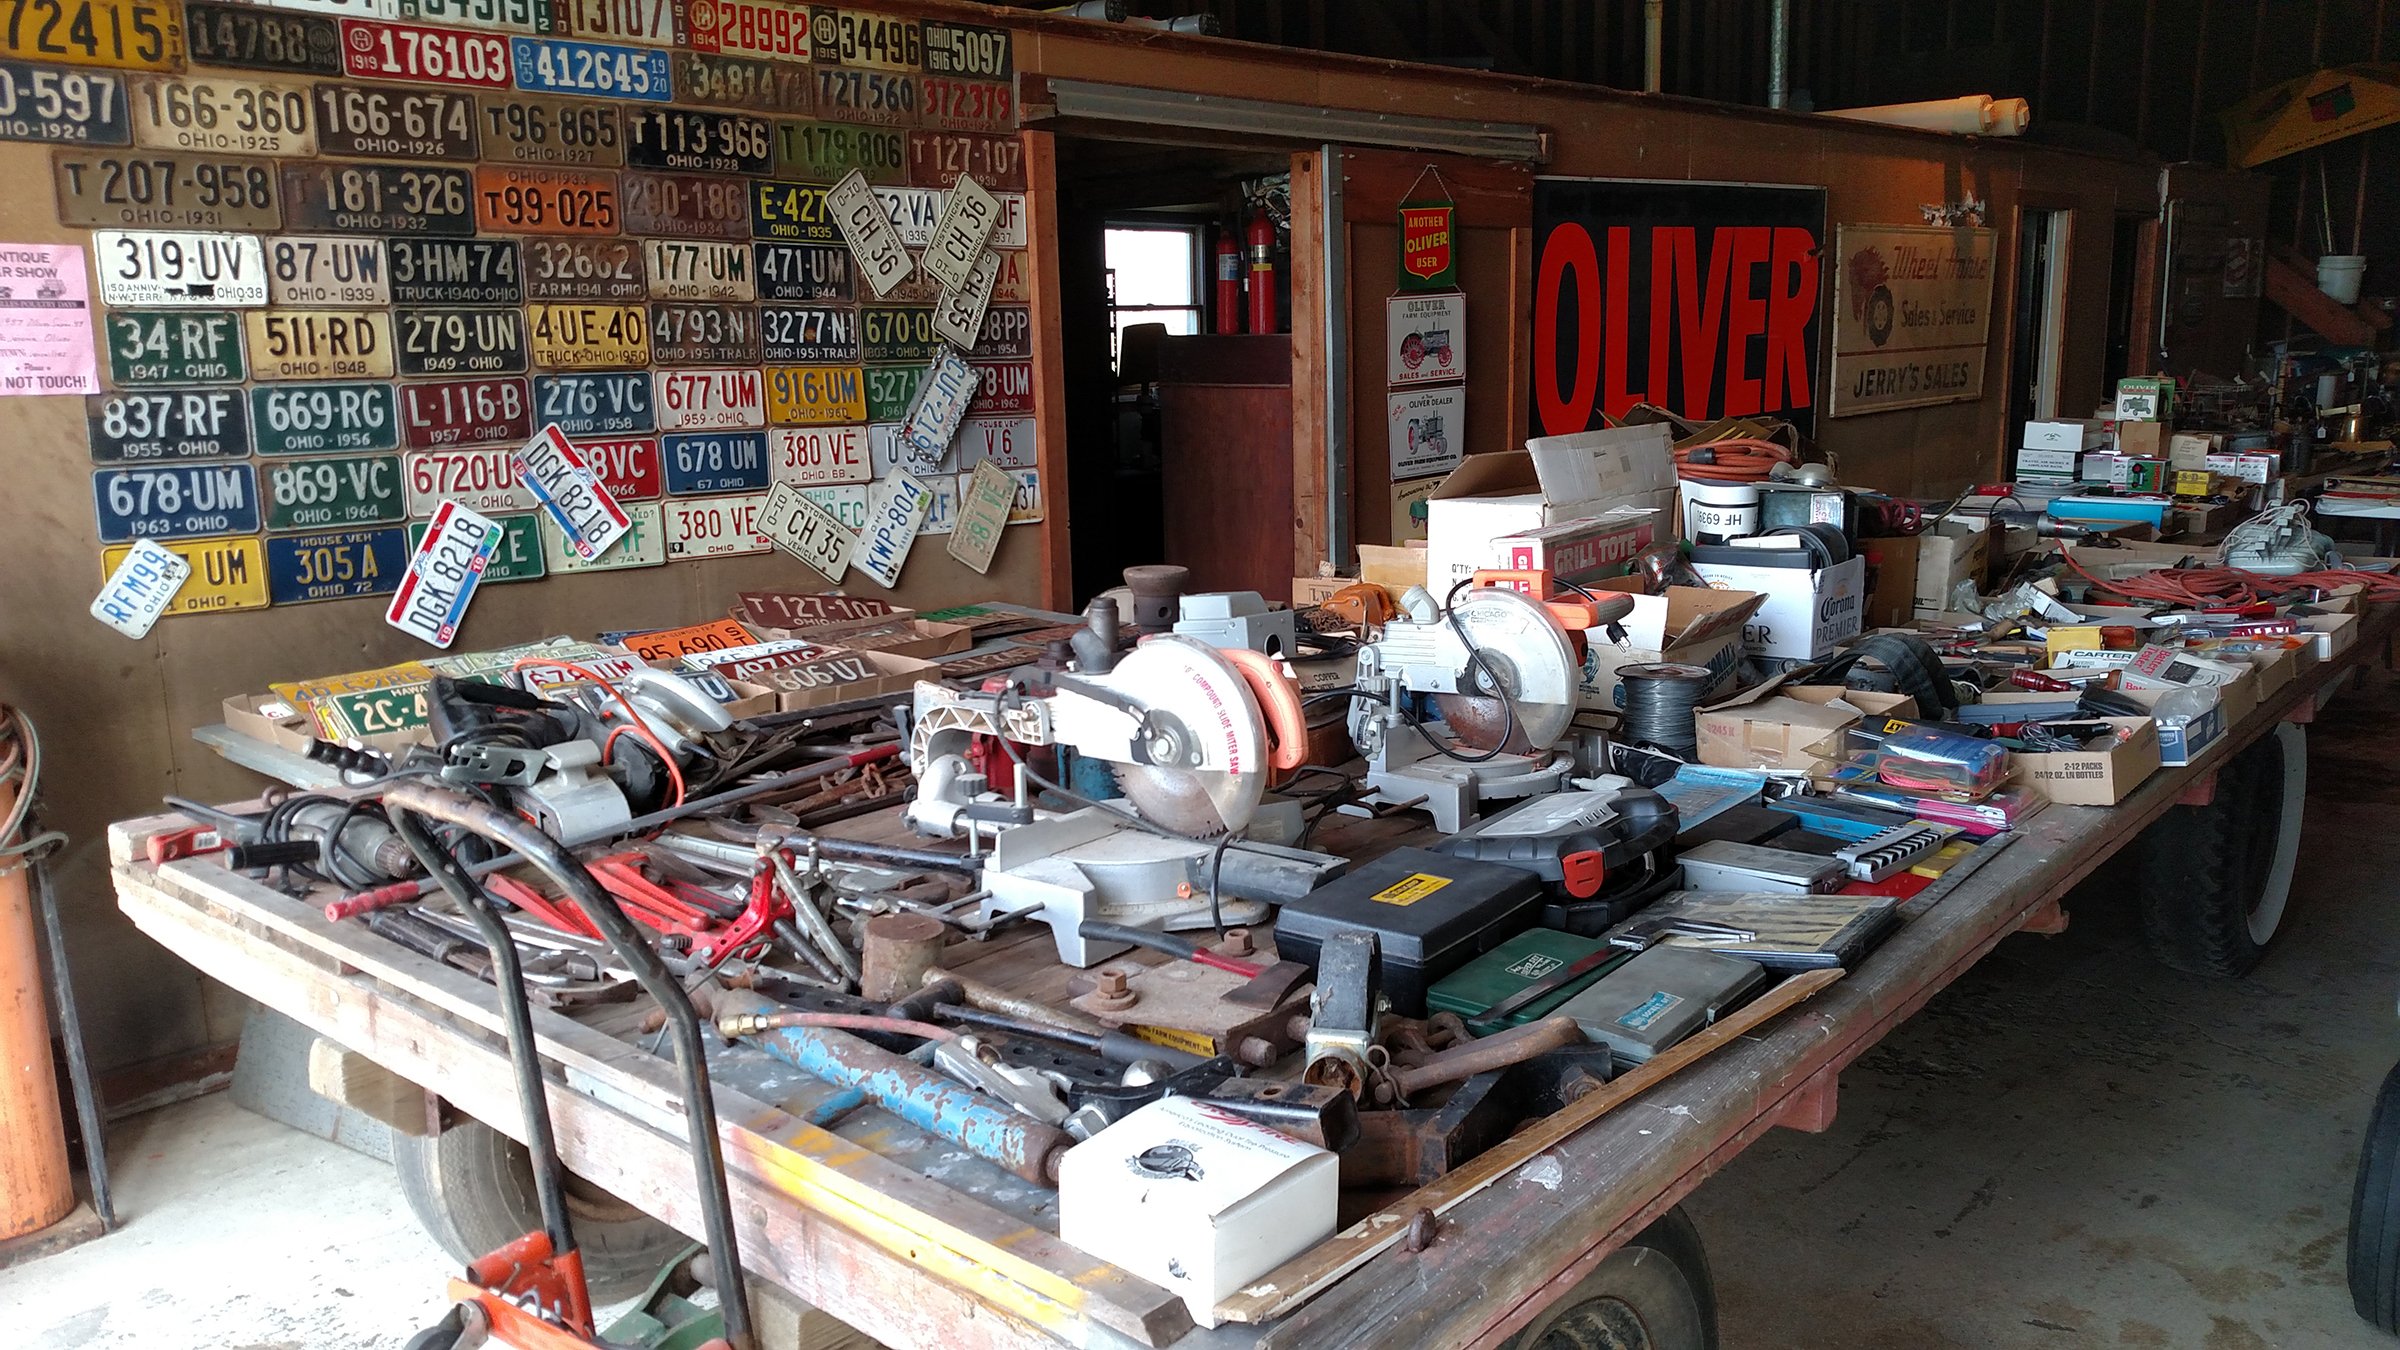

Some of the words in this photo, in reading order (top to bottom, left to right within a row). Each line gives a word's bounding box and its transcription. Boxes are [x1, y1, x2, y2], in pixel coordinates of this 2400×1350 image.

[193, 10, 307, 63] 14788
[692, 32, 717, 46] 1914
[721, 6, 809, 56] 28992
[841, 16, 920, 66] 34496
[926, 26, 950, 49] OHIO
[351, 54, 378, 71] 1919
[379, 29, 507, 82] 176103
[815, 47, 838, 60] 1915
[928, 50, 950, 70] 1916
[952, 30, 1006, 76] 5097
[537, 46, 649, 94] 412645
[143, 82, 305, 136] 166-360
[322, 90, 469, 141] 166-674
[101, 158, 271, 210] 207-958
[320, 168, 466, 216] 181-326
[1408, 215, 1444, 229] ANOTHER
[1406, 231, 1448, 254] OLIVER
[15, 267, 58, 279] SHOW
[1416, 256, 1438, 269] USER
[1406, 299, 1446, 313] OLIVER
[1535, 221, 1823, 438] OLIVER
[5, 376, 33, 390] NOT
[35, 375, 88, 389] TOUCH!
[1853, 362, 1920, 398] JERRY'S
[1922, 361, 1970, 391] SALES
[783, 435, 821, 468] 380
[827, 432, 860, 465] VE
[677, 509, 721, 541] 380
[294, 547, 351, 585] 305
[1553, 546, 1598, 577] GRILL
[1599, 530, 1638, 558] TOTE
[1821, 593, 1855, 624] Corona
[1816, 615, 1859, 646] PREMIER
[2074, 651, 2133, 660] CARTER
[2146, 649, 2173, 677] Battery
[1225, 729, 1239, 755] MITER
[1228, 754, 1241, 776] SAW
[2081, 762, 2104, 771] PACKS
